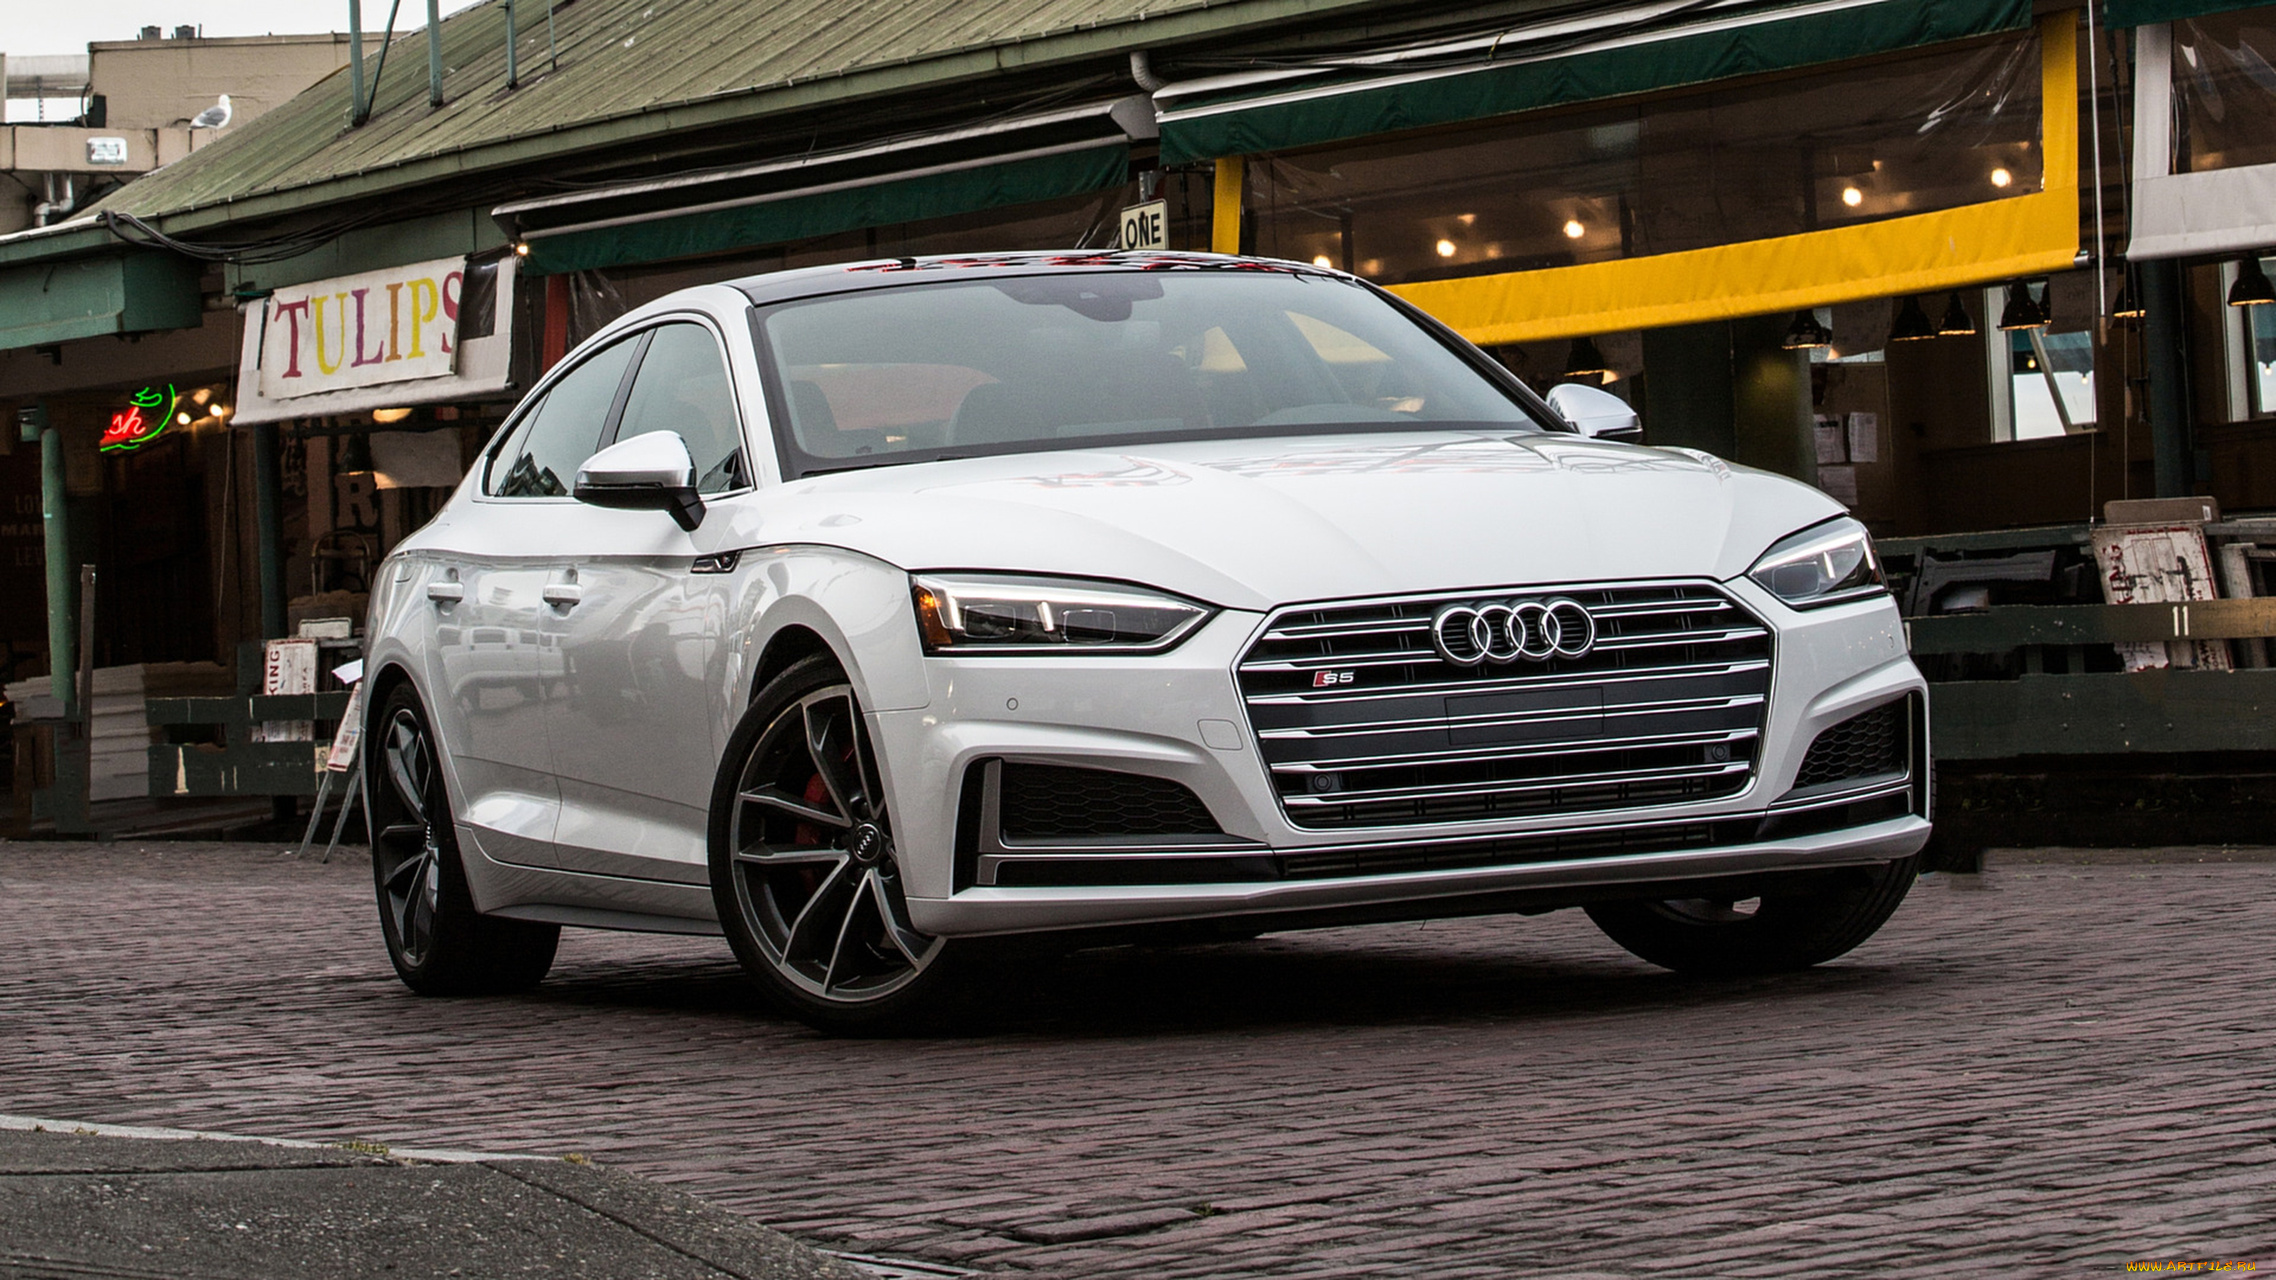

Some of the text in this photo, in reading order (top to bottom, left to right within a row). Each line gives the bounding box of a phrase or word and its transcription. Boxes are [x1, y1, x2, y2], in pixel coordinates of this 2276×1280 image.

[1126, 213, 1161, 249] ONE
[274, 270, 464, 379] TULIPS
[1318, 672, 1354, 685] S5
